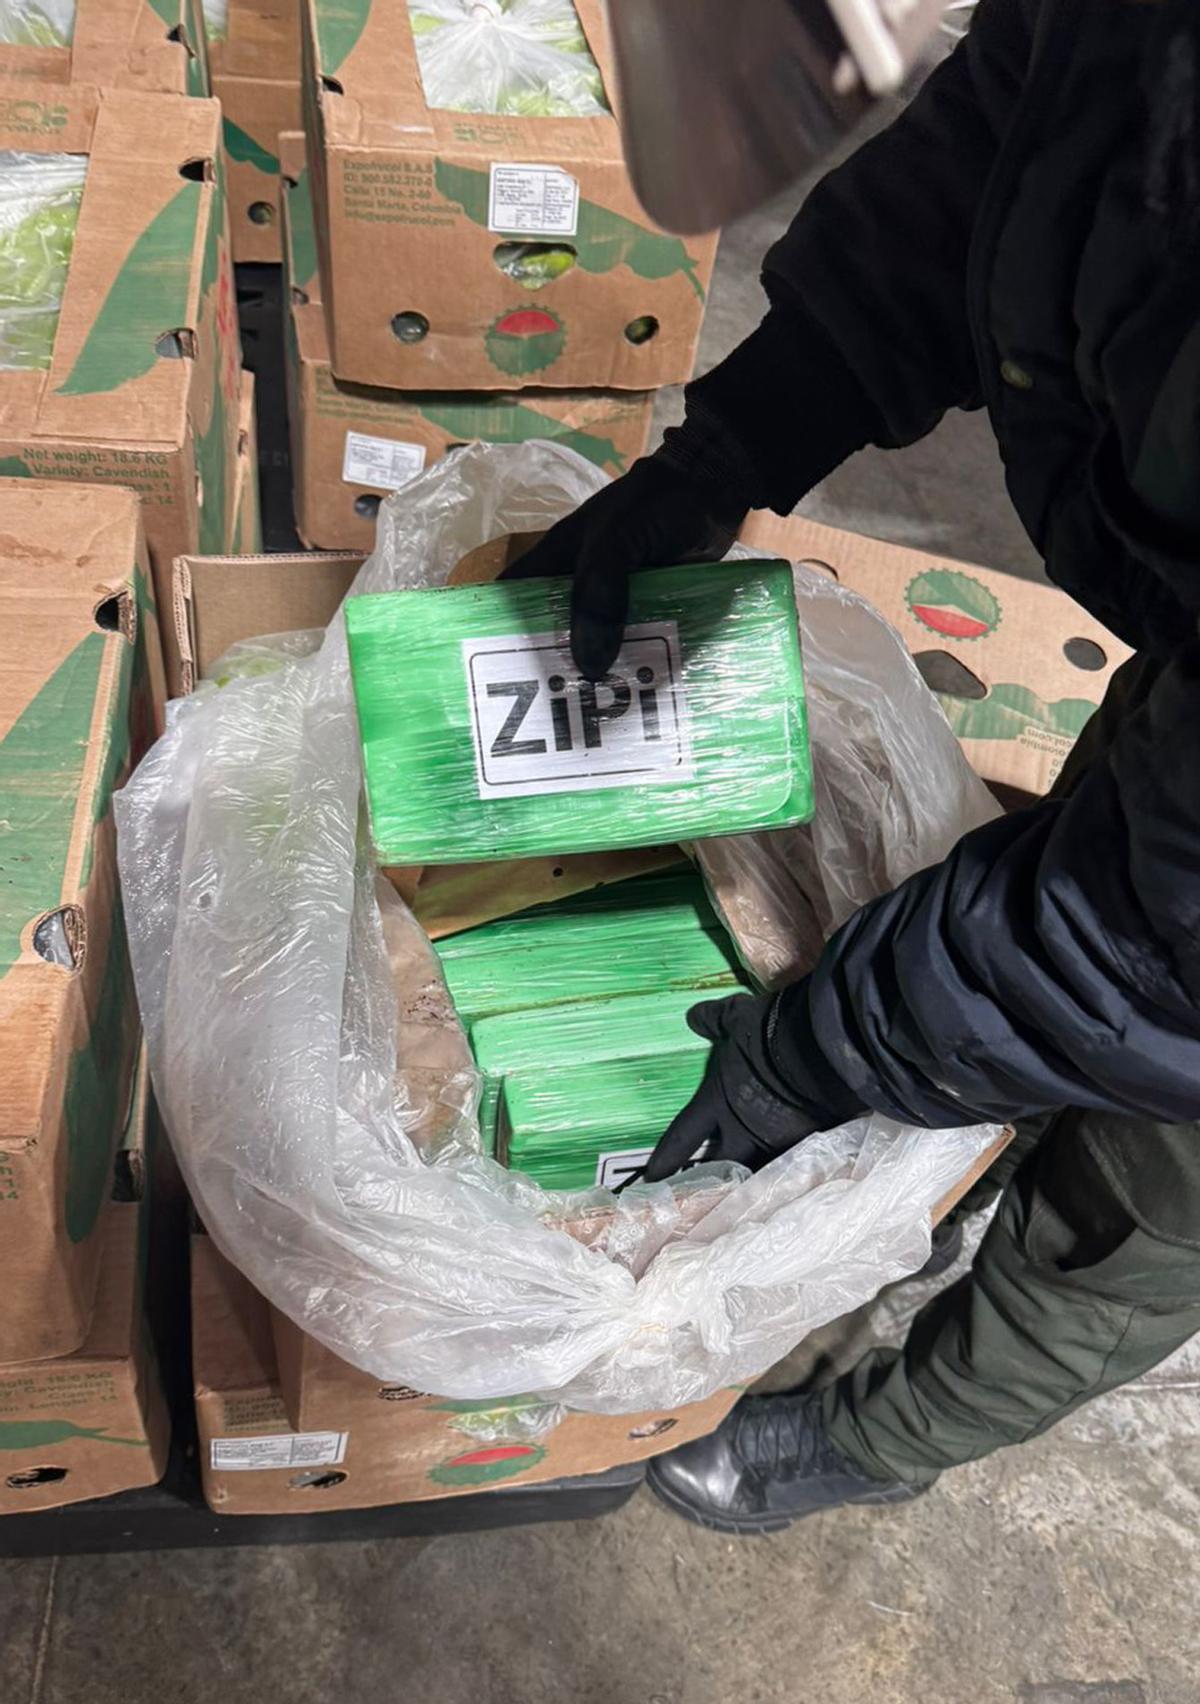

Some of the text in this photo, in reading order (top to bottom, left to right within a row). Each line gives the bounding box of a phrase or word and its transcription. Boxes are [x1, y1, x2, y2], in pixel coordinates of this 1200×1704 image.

[23, 448, 49, 461] Net
[53, 449, 107, 464] weight:
[145, 454, 168, 466] KG
[33, 463, 170, 479] Variety: Cavendish
[486, 666, 661, 758] ZiPi
[1019, 737, 1067, 757] olombia
